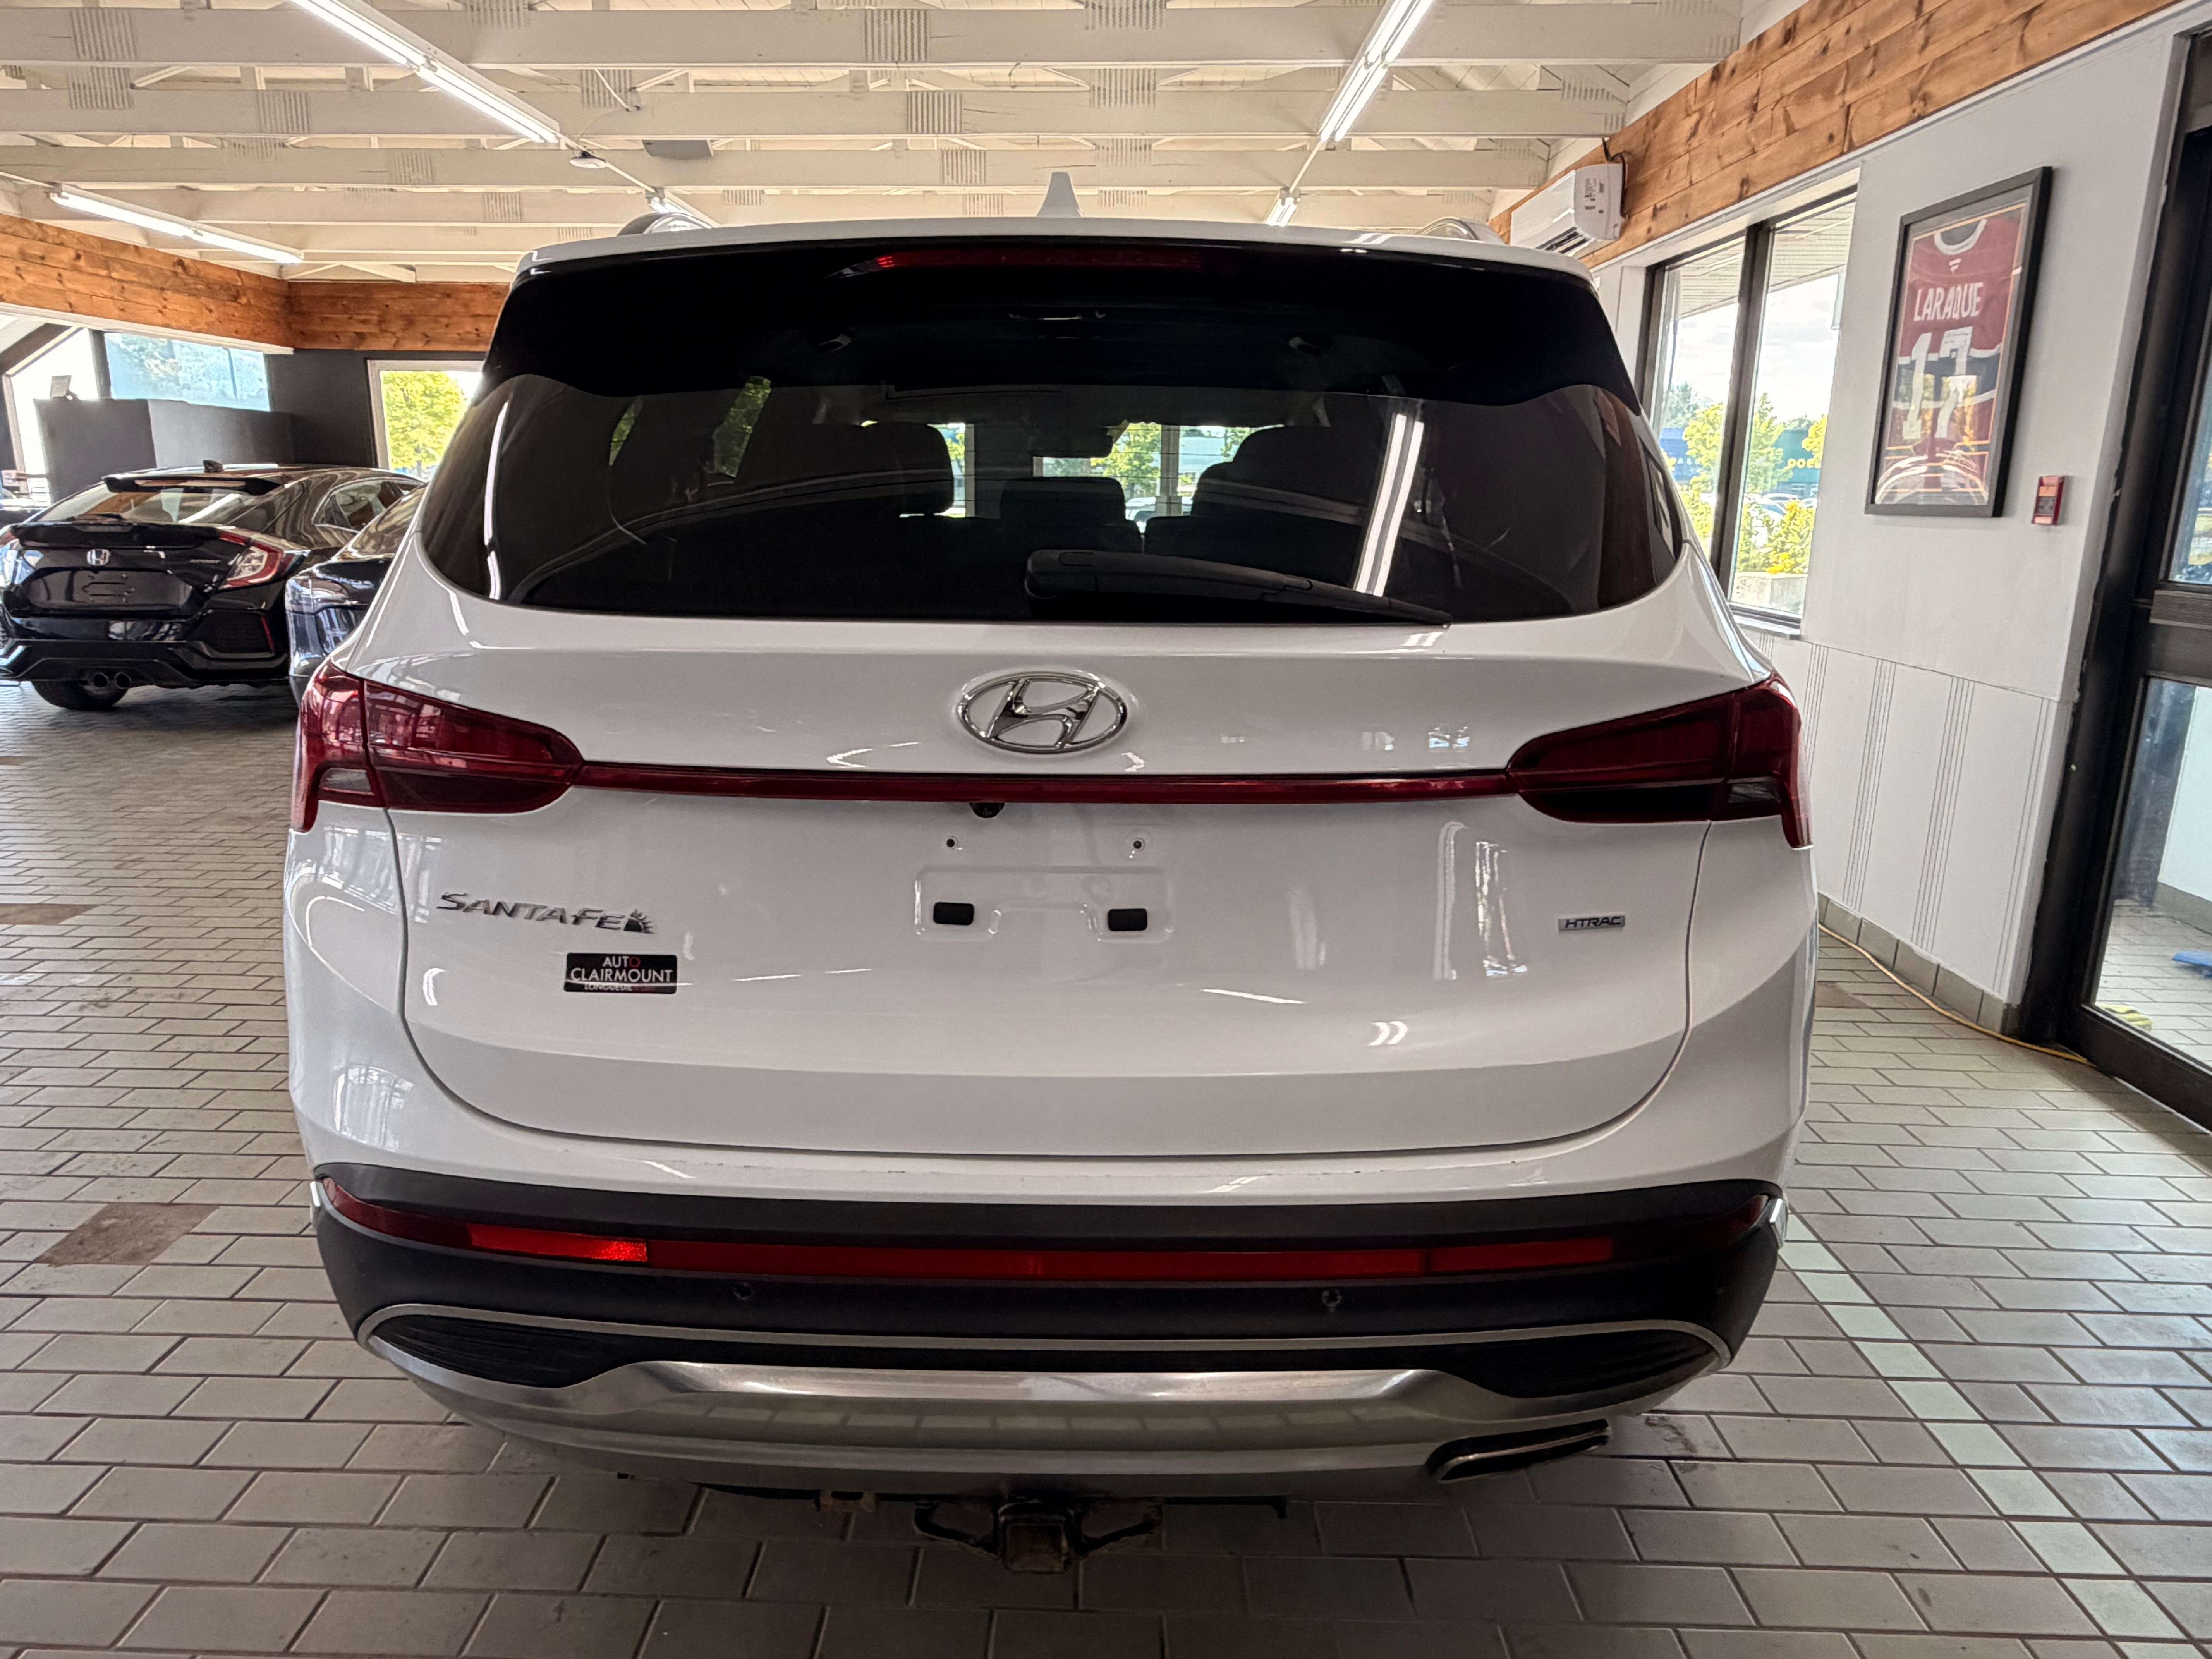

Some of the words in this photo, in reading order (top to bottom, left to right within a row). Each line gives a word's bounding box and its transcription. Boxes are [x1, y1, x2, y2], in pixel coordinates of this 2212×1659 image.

[1913, 282, 1983, 321] LARAQUE
[1903, 326, 1973, 440] 17
[1565, 916, 1621, 929] HTRAC
[603, 956, 641, 967] AUTO
[571, 968, 673, 982] CLAIRMOUNT
